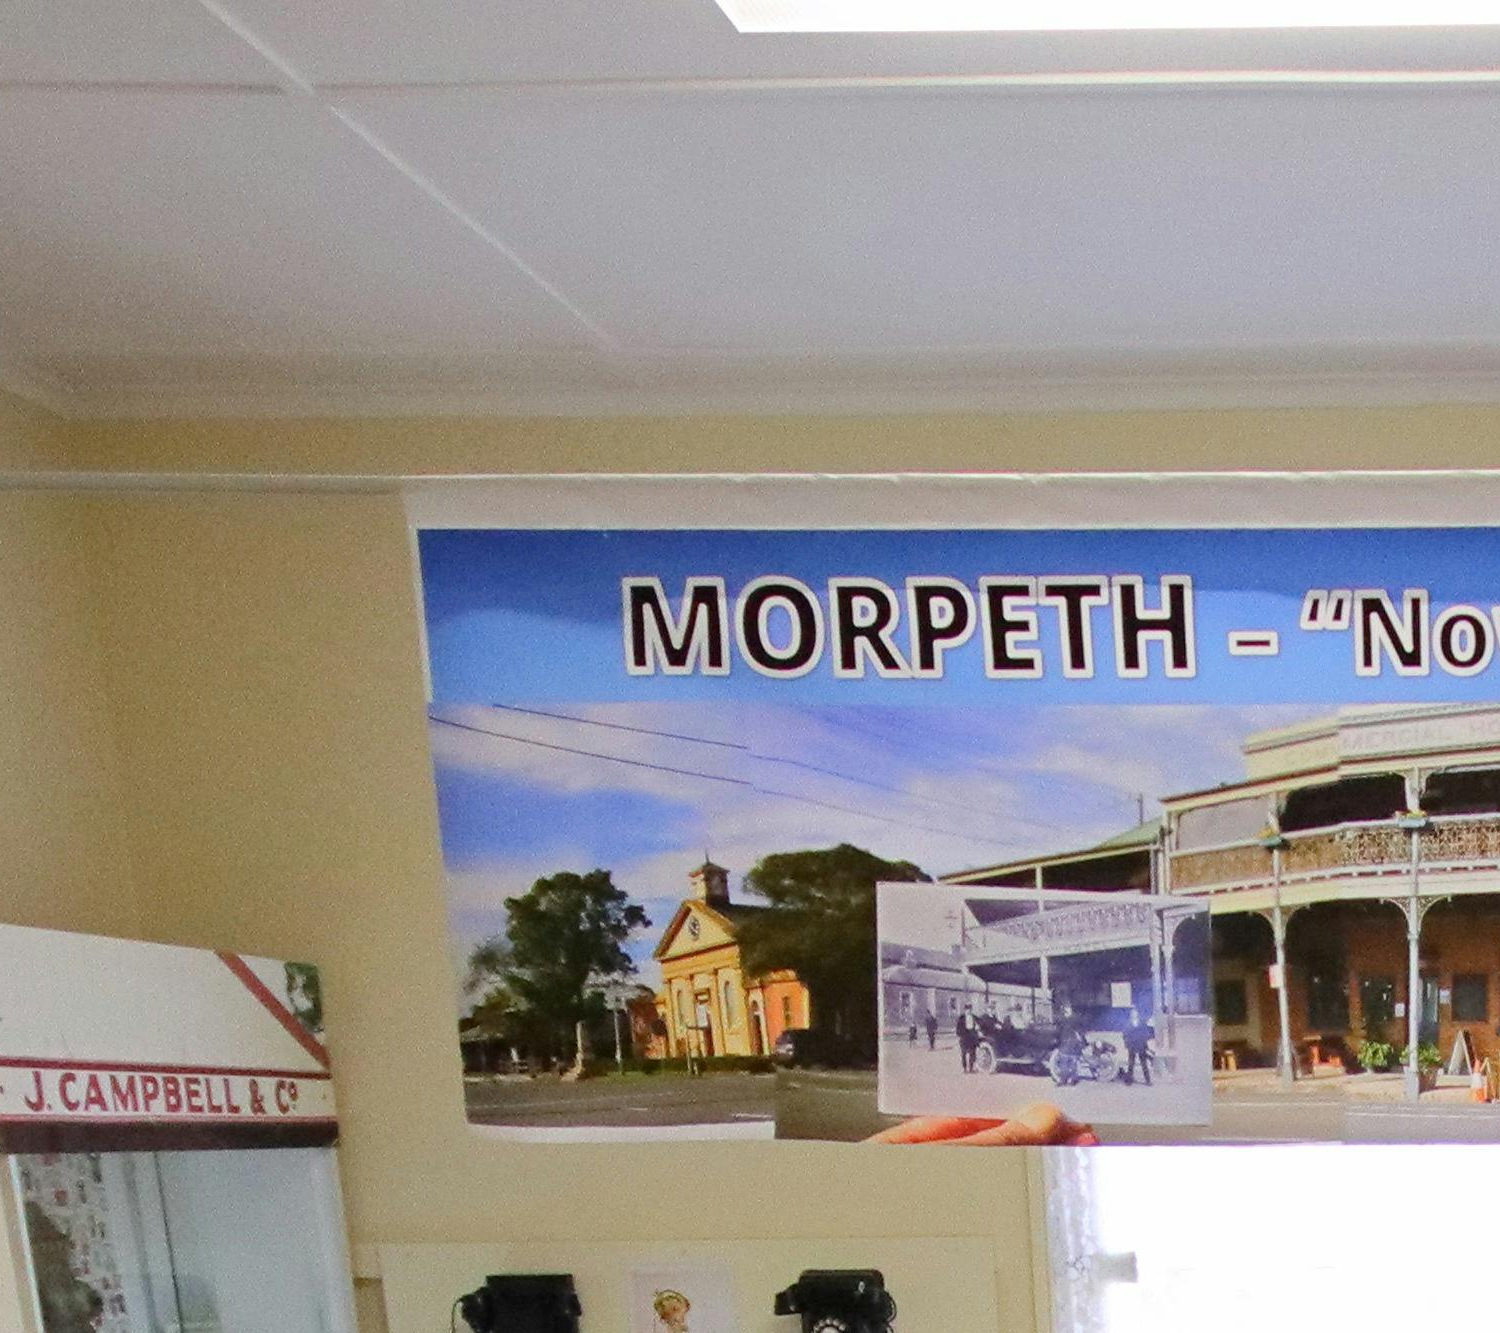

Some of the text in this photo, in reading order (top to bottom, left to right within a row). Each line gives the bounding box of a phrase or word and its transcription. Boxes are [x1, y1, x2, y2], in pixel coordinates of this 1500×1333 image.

[622, 575, 1197, 679] MORPETH
[59, 1072, 241, 1115] CAMPBELL
[249, 1079, 266, 1115] &
